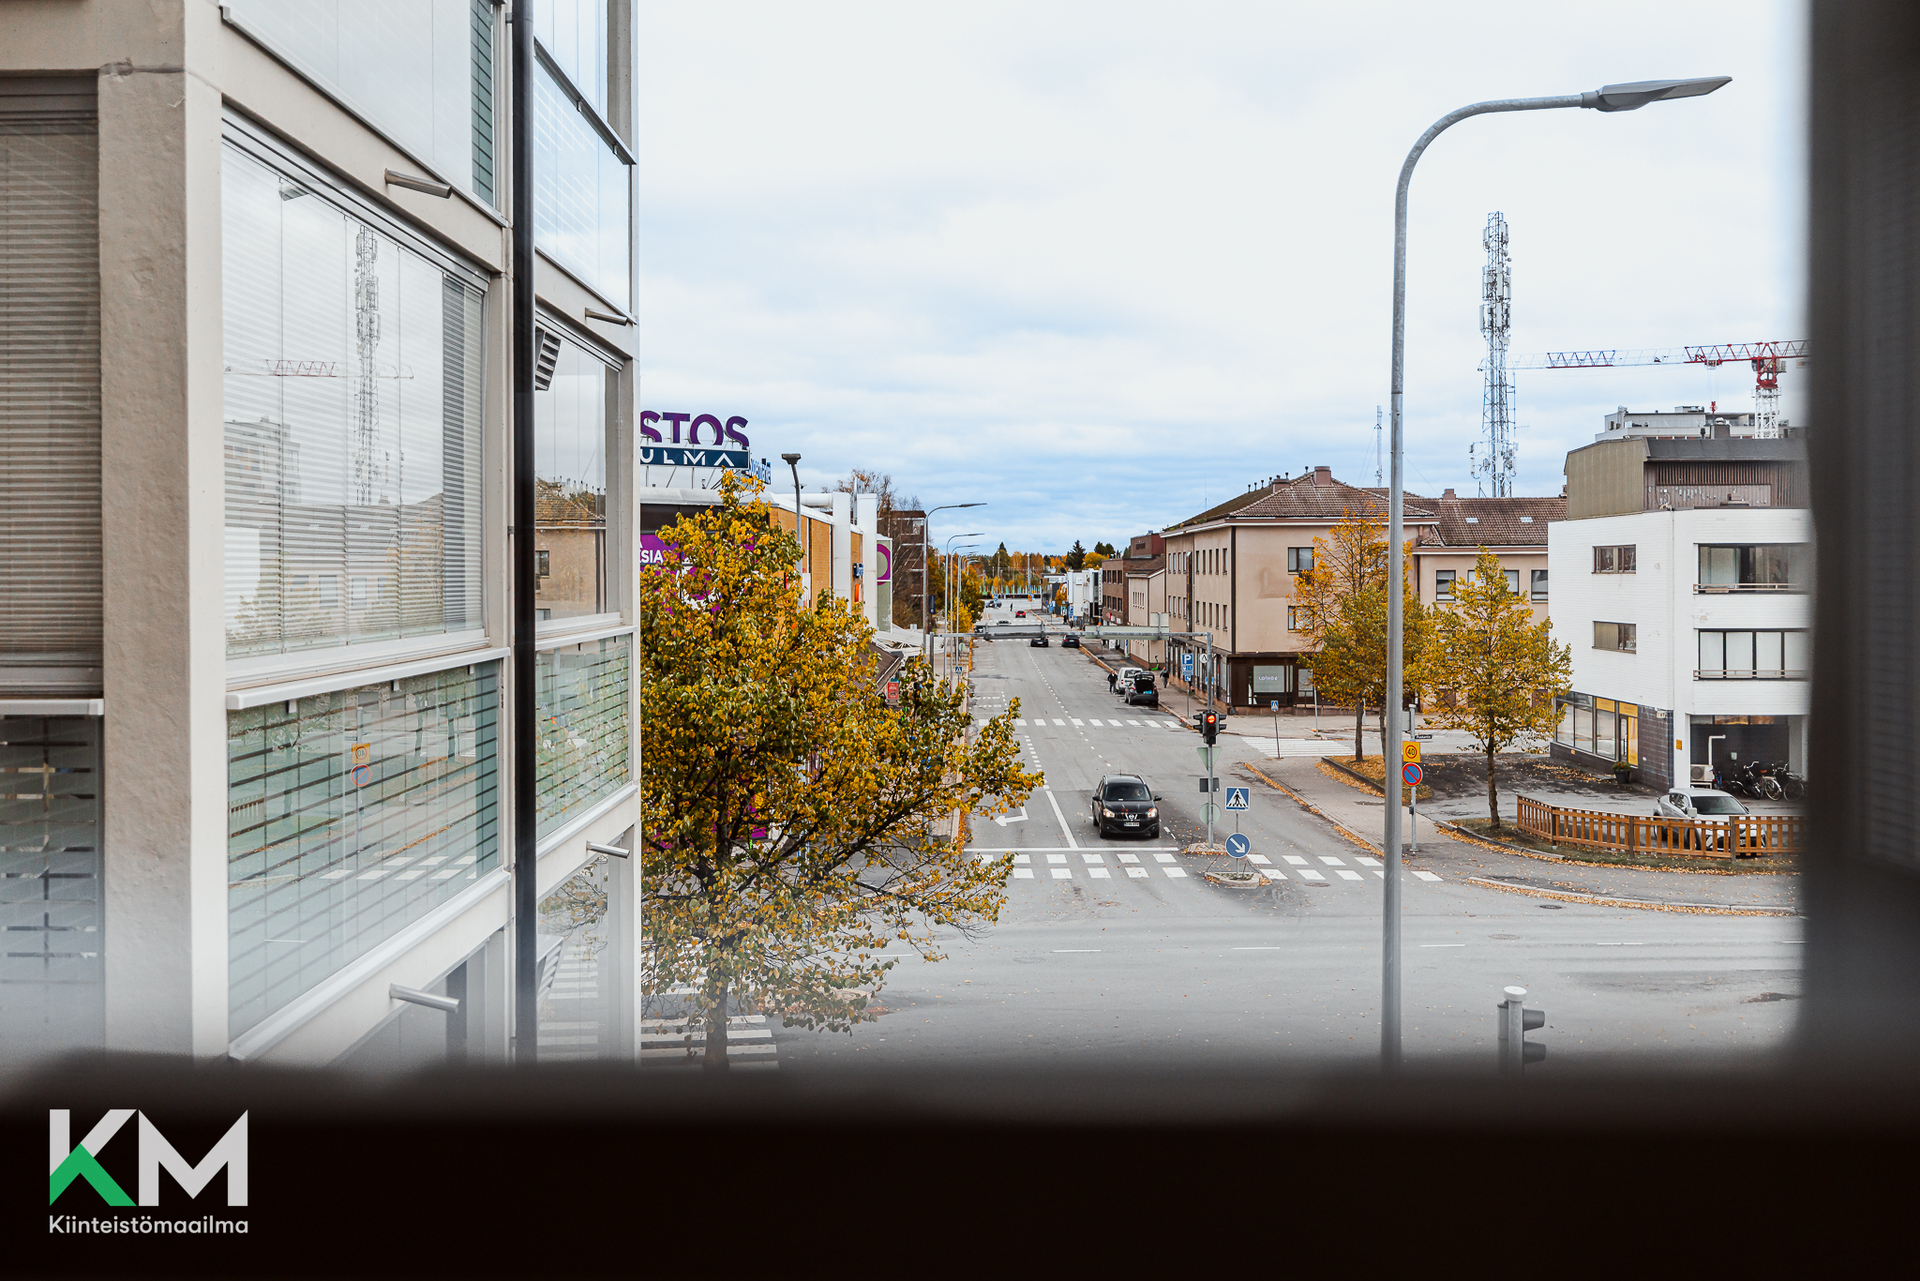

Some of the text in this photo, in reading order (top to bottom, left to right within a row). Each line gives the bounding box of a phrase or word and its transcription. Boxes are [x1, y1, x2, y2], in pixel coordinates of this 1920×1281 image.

[640, 410, 749, 447] STOS
[640, 549, 664, 564] SIA
[1184, 654, 1192, 664] P
[1407, 747, 1416, 756] 40
